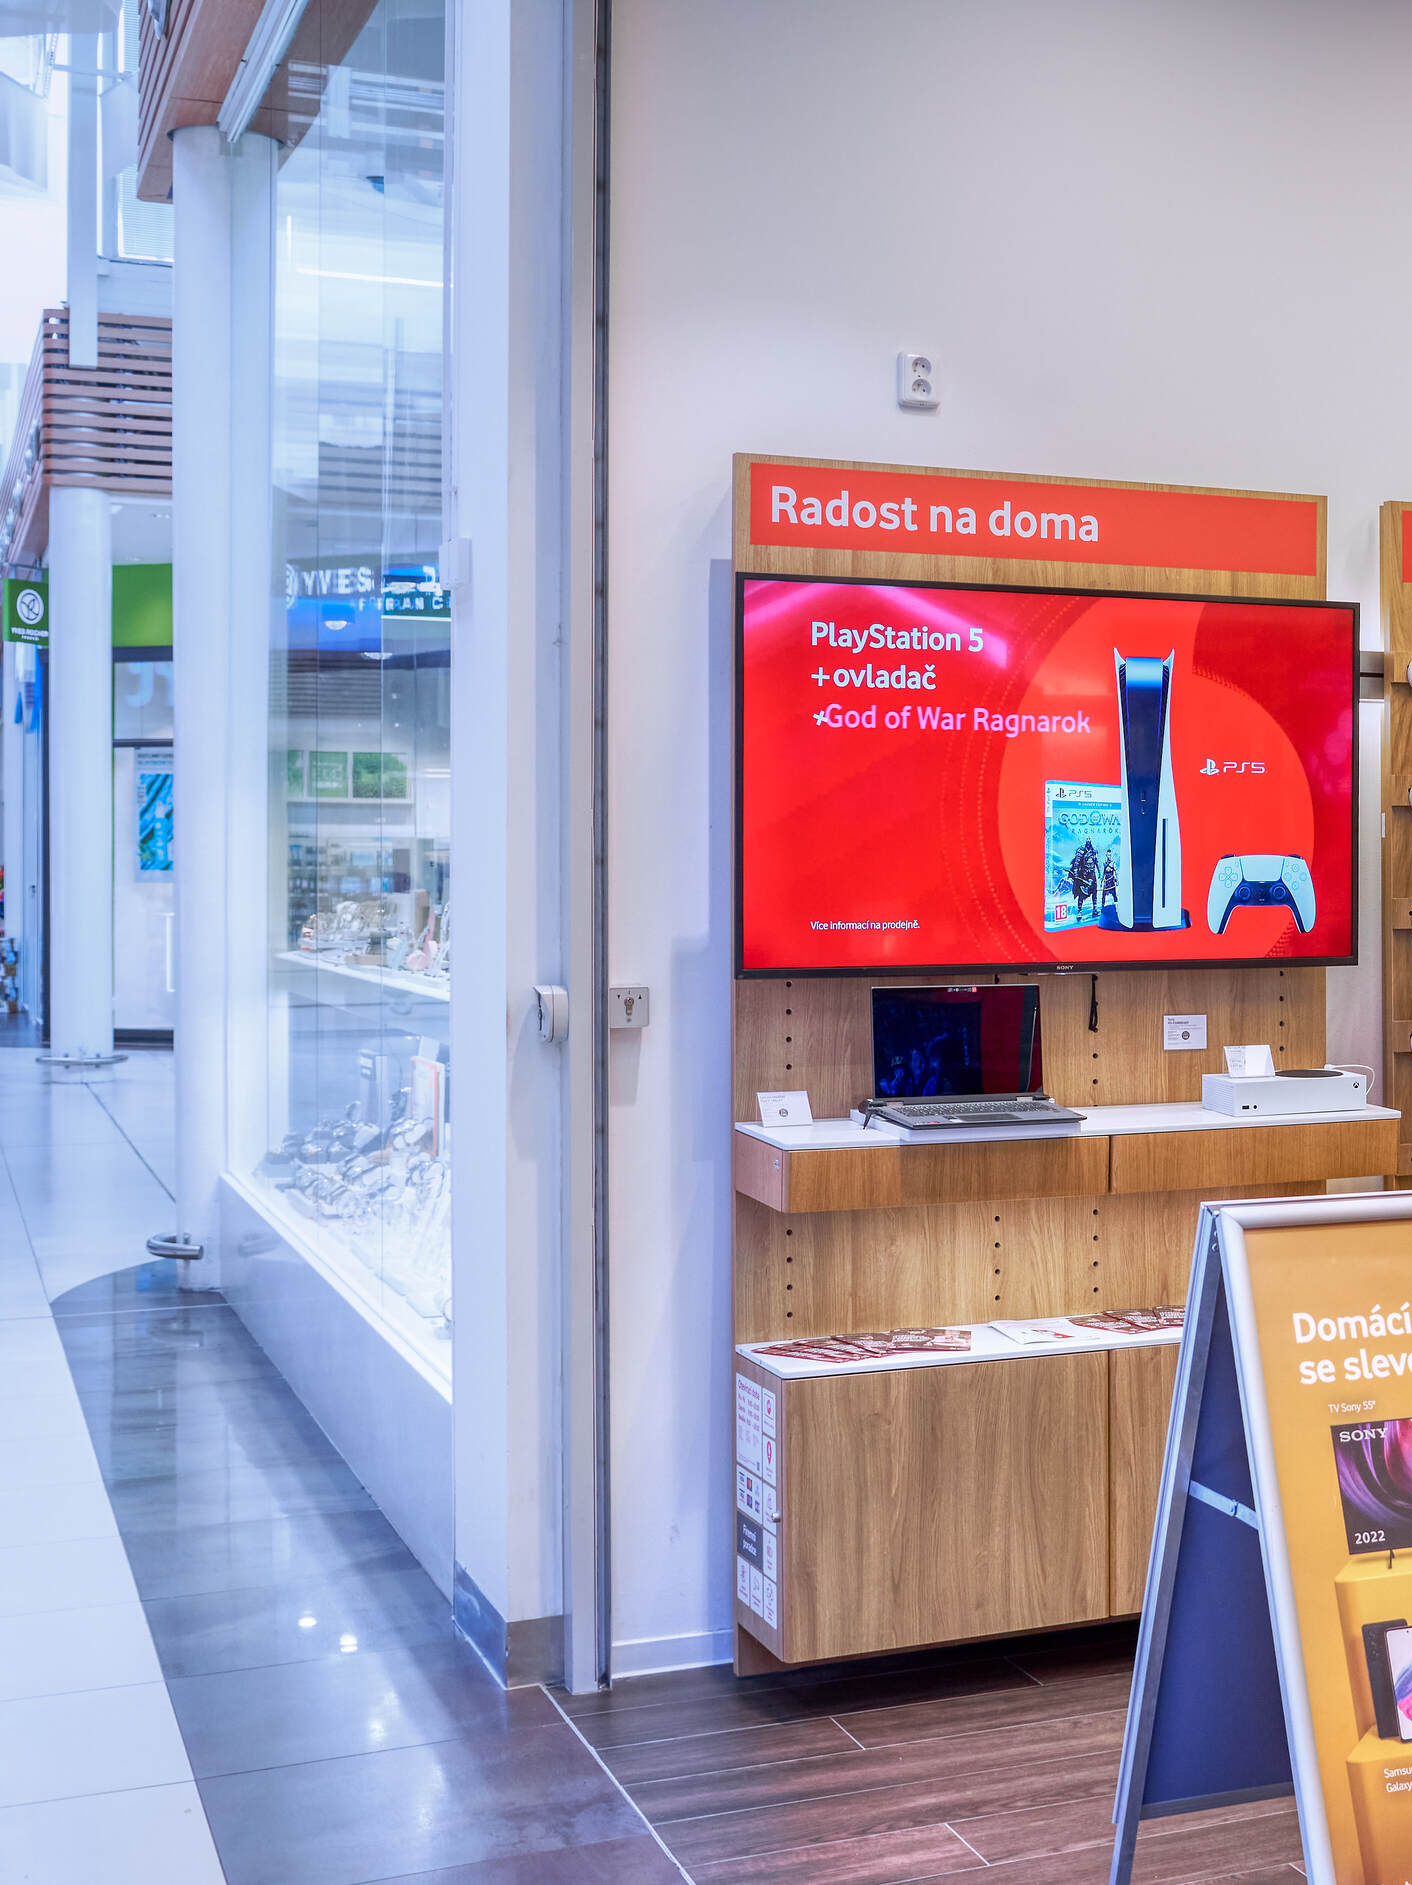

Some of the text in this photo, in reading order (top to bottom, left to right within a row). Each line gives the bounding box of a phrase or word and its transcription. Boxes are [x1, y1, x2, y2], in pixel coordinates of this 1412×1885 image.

[771, 485, 1099, 542] Radost na doma
[811, 621, 984, 653] PlayStation 5
[884, 705, 911, 730] of
[917, 706, 966, 731] War
[973, 708, 1091, 738] Ragnarok
[1223, 761, 1266, 774] PS5
[1056, 906, 1068, 919] 18
[810, 919, 920, 931] Více informací na prodejně.
[1293, 1302, 1412, 1344] Domácí
[1299, 1359, 1336, 1385] se
[1328, 1403, 1340, 1414] TV
[1341, 1402, 1362, 1413] Sony
[1339, 1427, 1388, 1442] SONY
[1354, 1530, 1386, 1545] 2022
[1385, 1780, 1412, 1793] Galaxy
